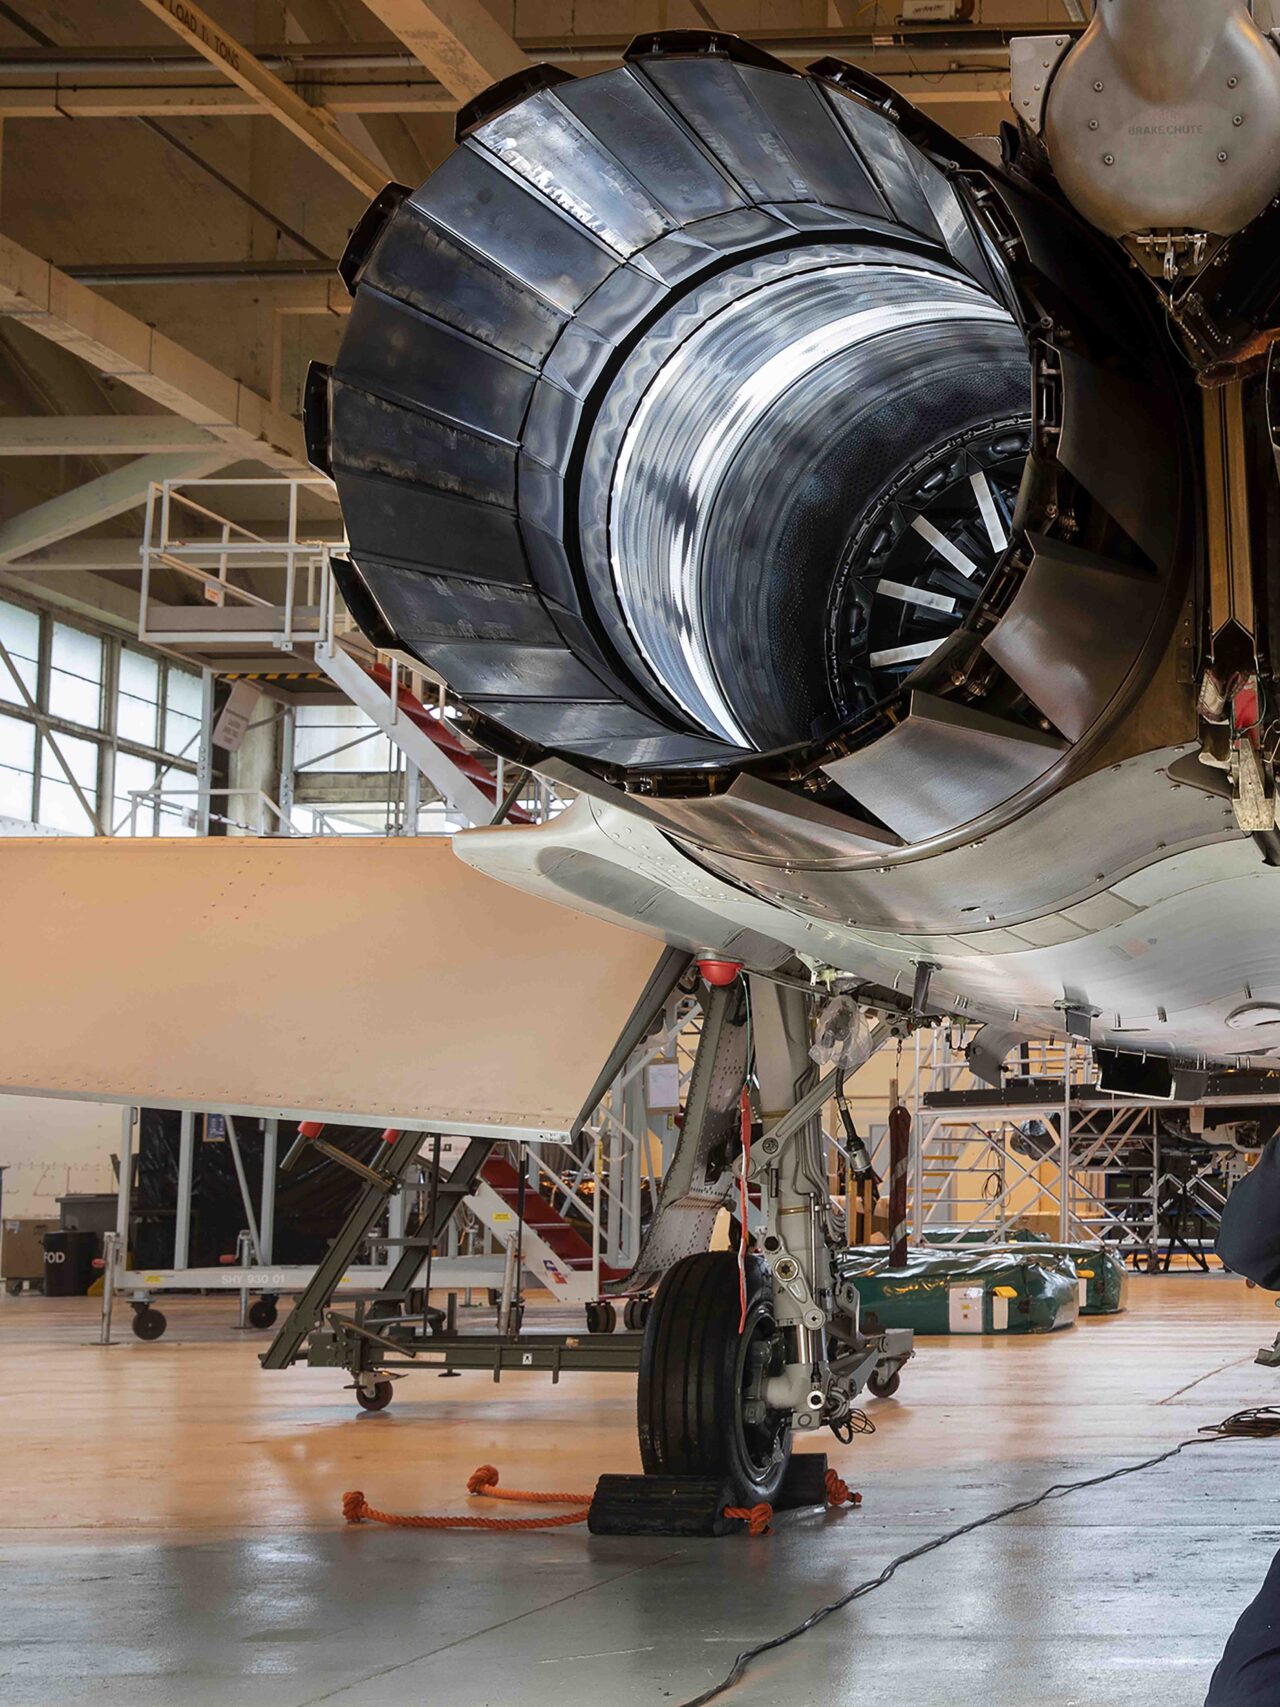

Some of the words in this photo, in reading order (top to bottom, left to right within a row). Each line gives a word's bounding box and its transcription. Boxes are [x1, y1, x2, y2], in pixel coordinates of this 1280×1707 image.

[214, 35, 240, 71] TONS
[1128, 126, 1165, 136] BRAKE
[1166, 124, 1204, 135] CHUTE
[43, 1251, 65, 1264] FOD
[221, 1274, 242, 1285] SHY
[247, 1274, 269, 1284] 930
[272, 1274, 285, 1284] 01
